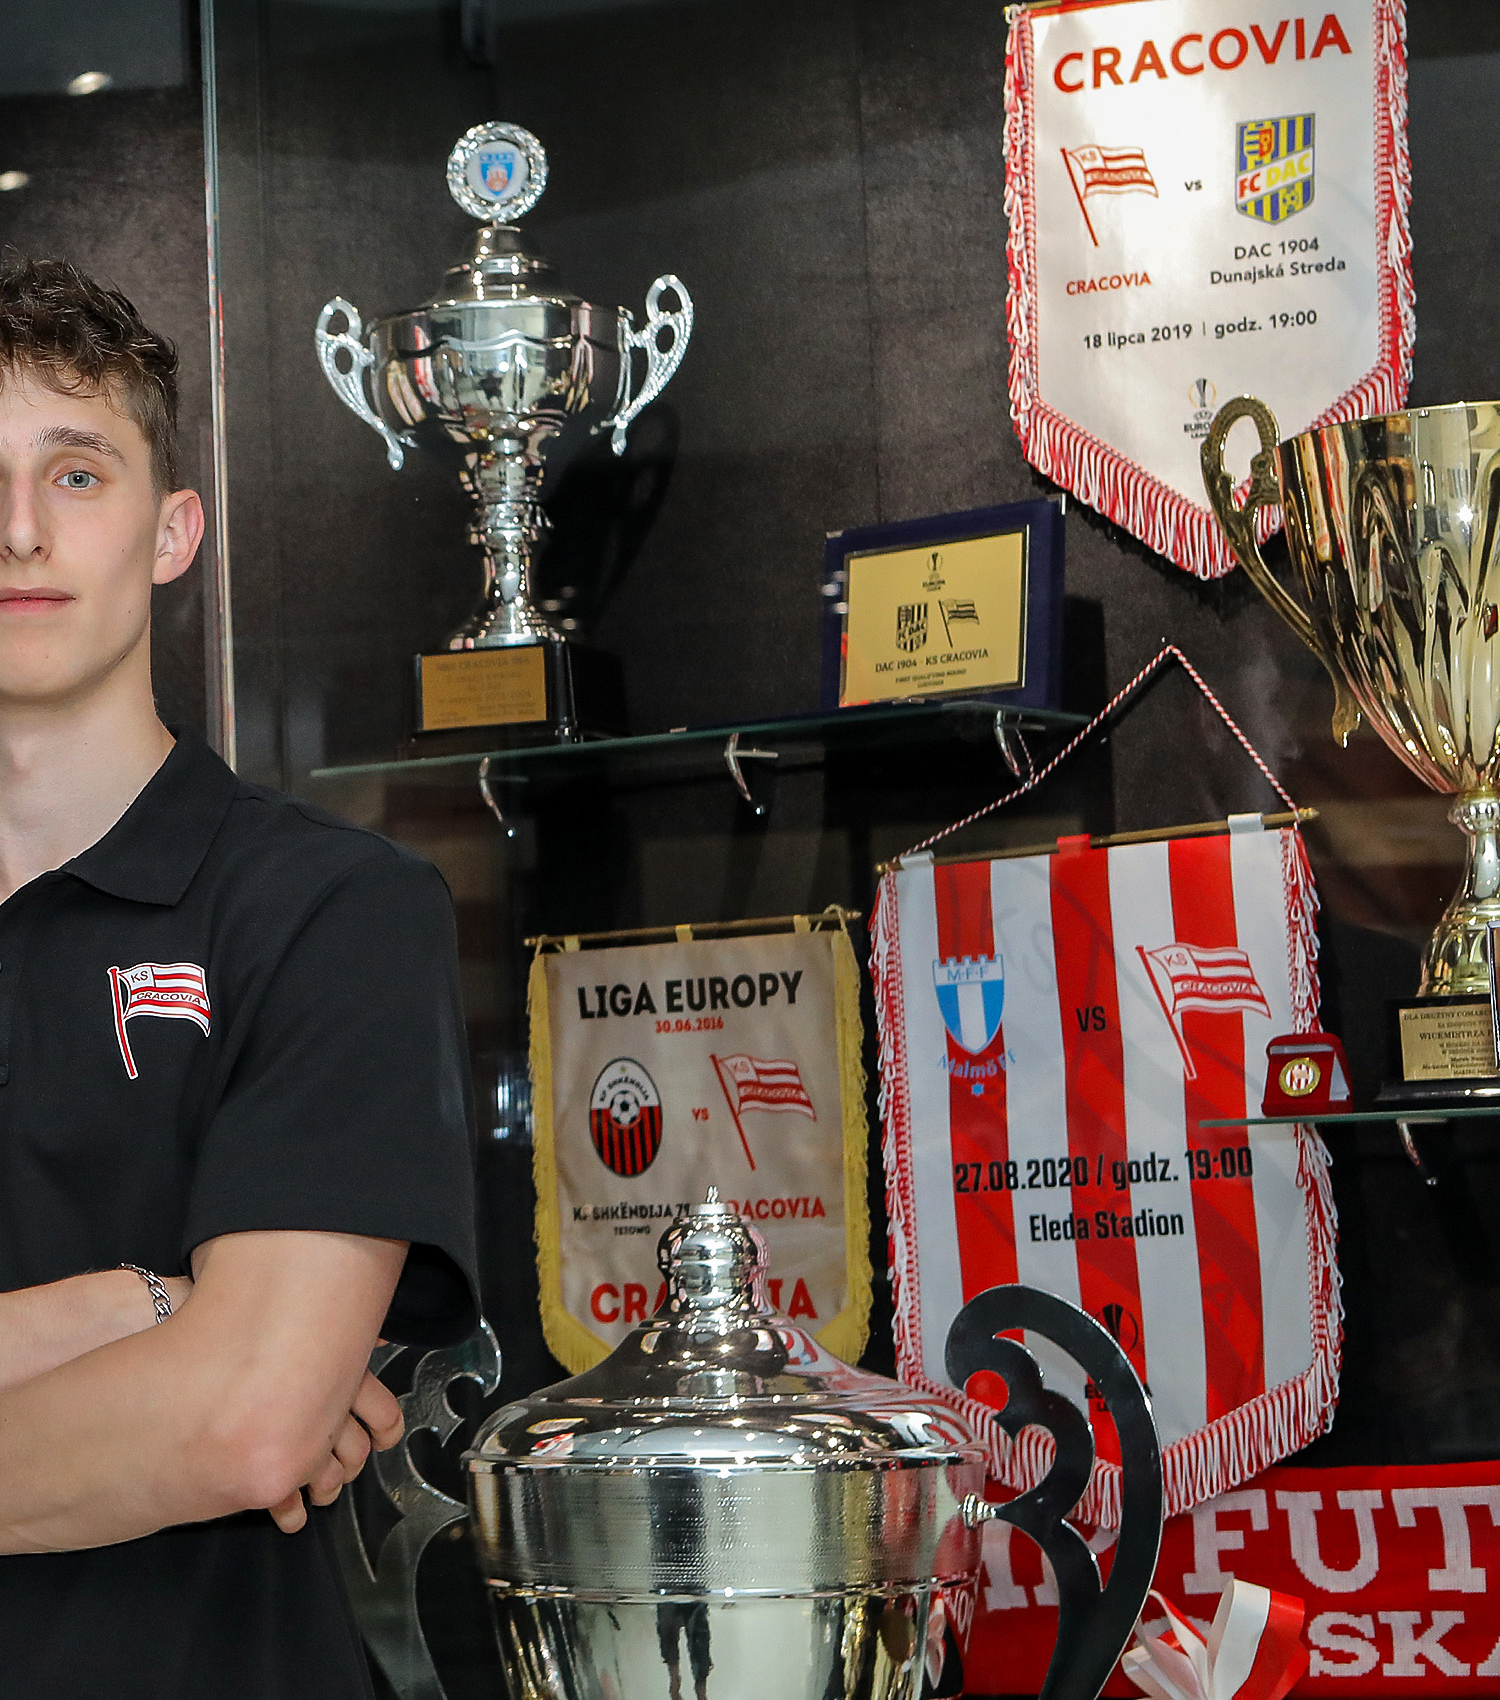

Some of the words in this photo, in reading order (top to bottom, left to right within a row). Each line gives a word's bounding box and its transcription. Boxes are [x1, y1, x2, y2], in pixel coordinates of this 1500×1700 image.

[1053, 14, 1352, 93] CRACOVIA
[1238, 172, 1261, 200] FC
[1266, 152, 1311, 188] DAC
[1234, 243, 1272, 260] DAC
[1278, 237, 1320, 255] 1904
[1066, 271, 1152, 297] CRACOVIA
[1209, 263, 1285, 285] Dunajská
[1290, 257, 1346, 278] Streda
[1083, 333, 1102, 350] 18
[1107, 329, 1146, 351] lipca
[1151, 323, 1193, 343] 2019
[1214, 316, 1263, 340] godz.
[1269, 309, 1318, 330] 19:00
[875, 661, 894, 673] DAC
[925, 655, 938, 666] KS
[939, 648, 989, 664] CRACOVIA
[1164, 952, 1188, 968] KS
[130, 970, 149, 984] KS
[1180, 980, 1253, 995] CRACOVIA
[136, 992, 201, 1006] CRACOVIA
[578, 982, 656, 1020] LIGA
[665, 971, 803, 1012] EUROPY
[655, 1018, 725, 1033] 30.06.2016
[1076, 1006, 1107, 1033] VS
[938, 1052, 997, 1079] Malmö
[692, 1107, 710, 1123] VS
[954, 1156, 1089, 1194] 27.08.2020
[1112, 1151, 1180, 1190] godz.
[1184, 1146, 1254, 1181] 19:00
[728, 1196, 827, 1220] RACOVIA
[1030, 1213, 1091, 1242] Eleda
[1096, 1208, 1186, 1240] Stadion
[1307, 1610, 1500, 1678] SK
